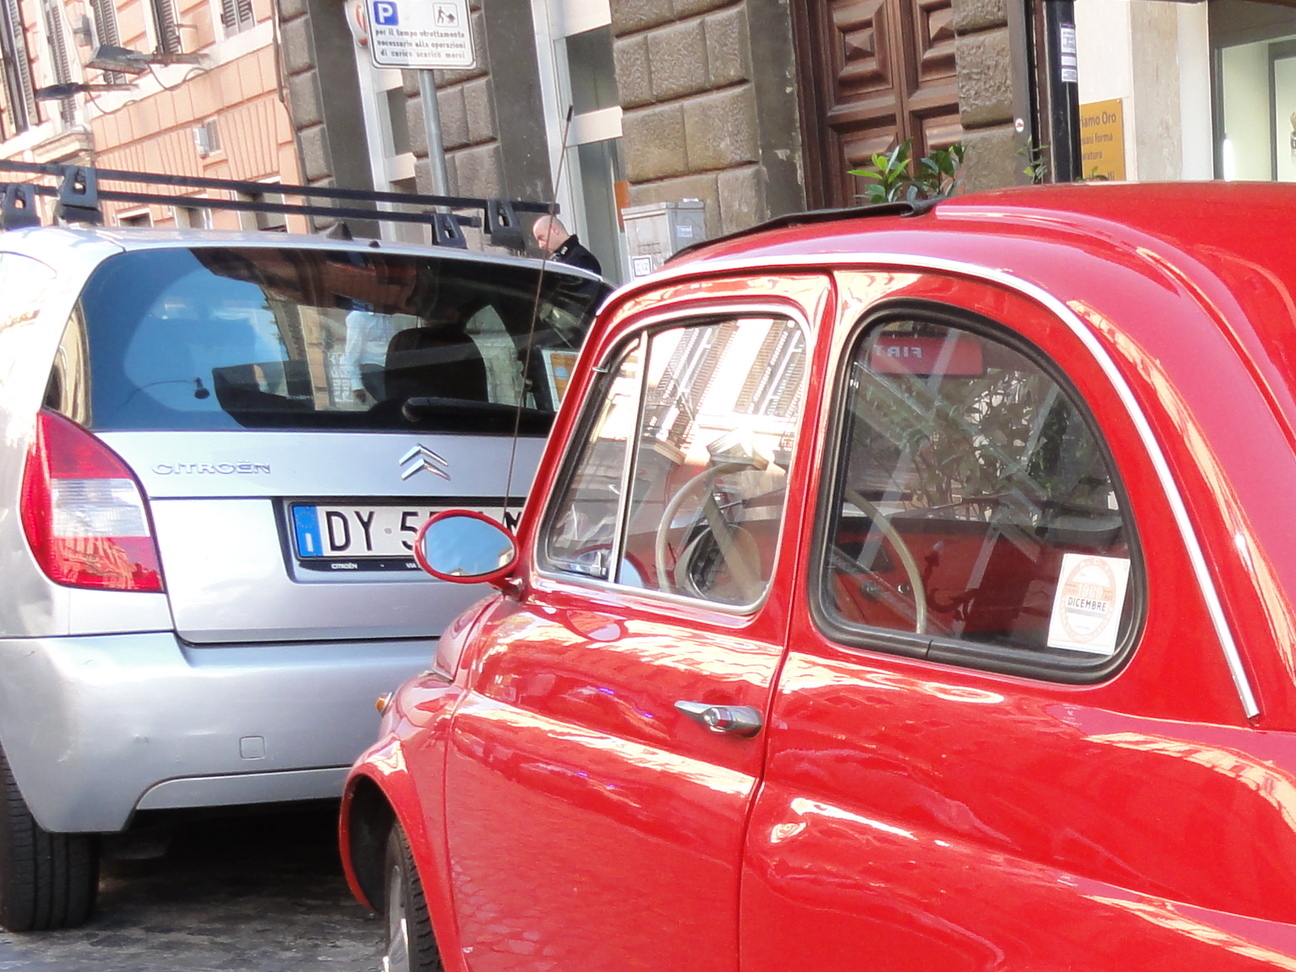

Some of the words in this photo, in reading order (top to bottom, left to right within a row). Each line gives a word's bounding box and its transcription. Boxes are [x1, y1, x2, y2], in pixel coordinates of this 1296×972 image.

[378, 3, 393, 23] P
[396, 29, 418, 38] tempo
[1081, 114, 1100, 128] iamo
[1102, 111, 1117, 125] Oro
[1095, 132, 1113, 143] forma
[151, 459, 271, 476] CITROËN
[325, 510, 375, 551] DY
[331, 562, 358, 570] CITROËN
[1067, 597, 1107, 611] DICEMBRE
